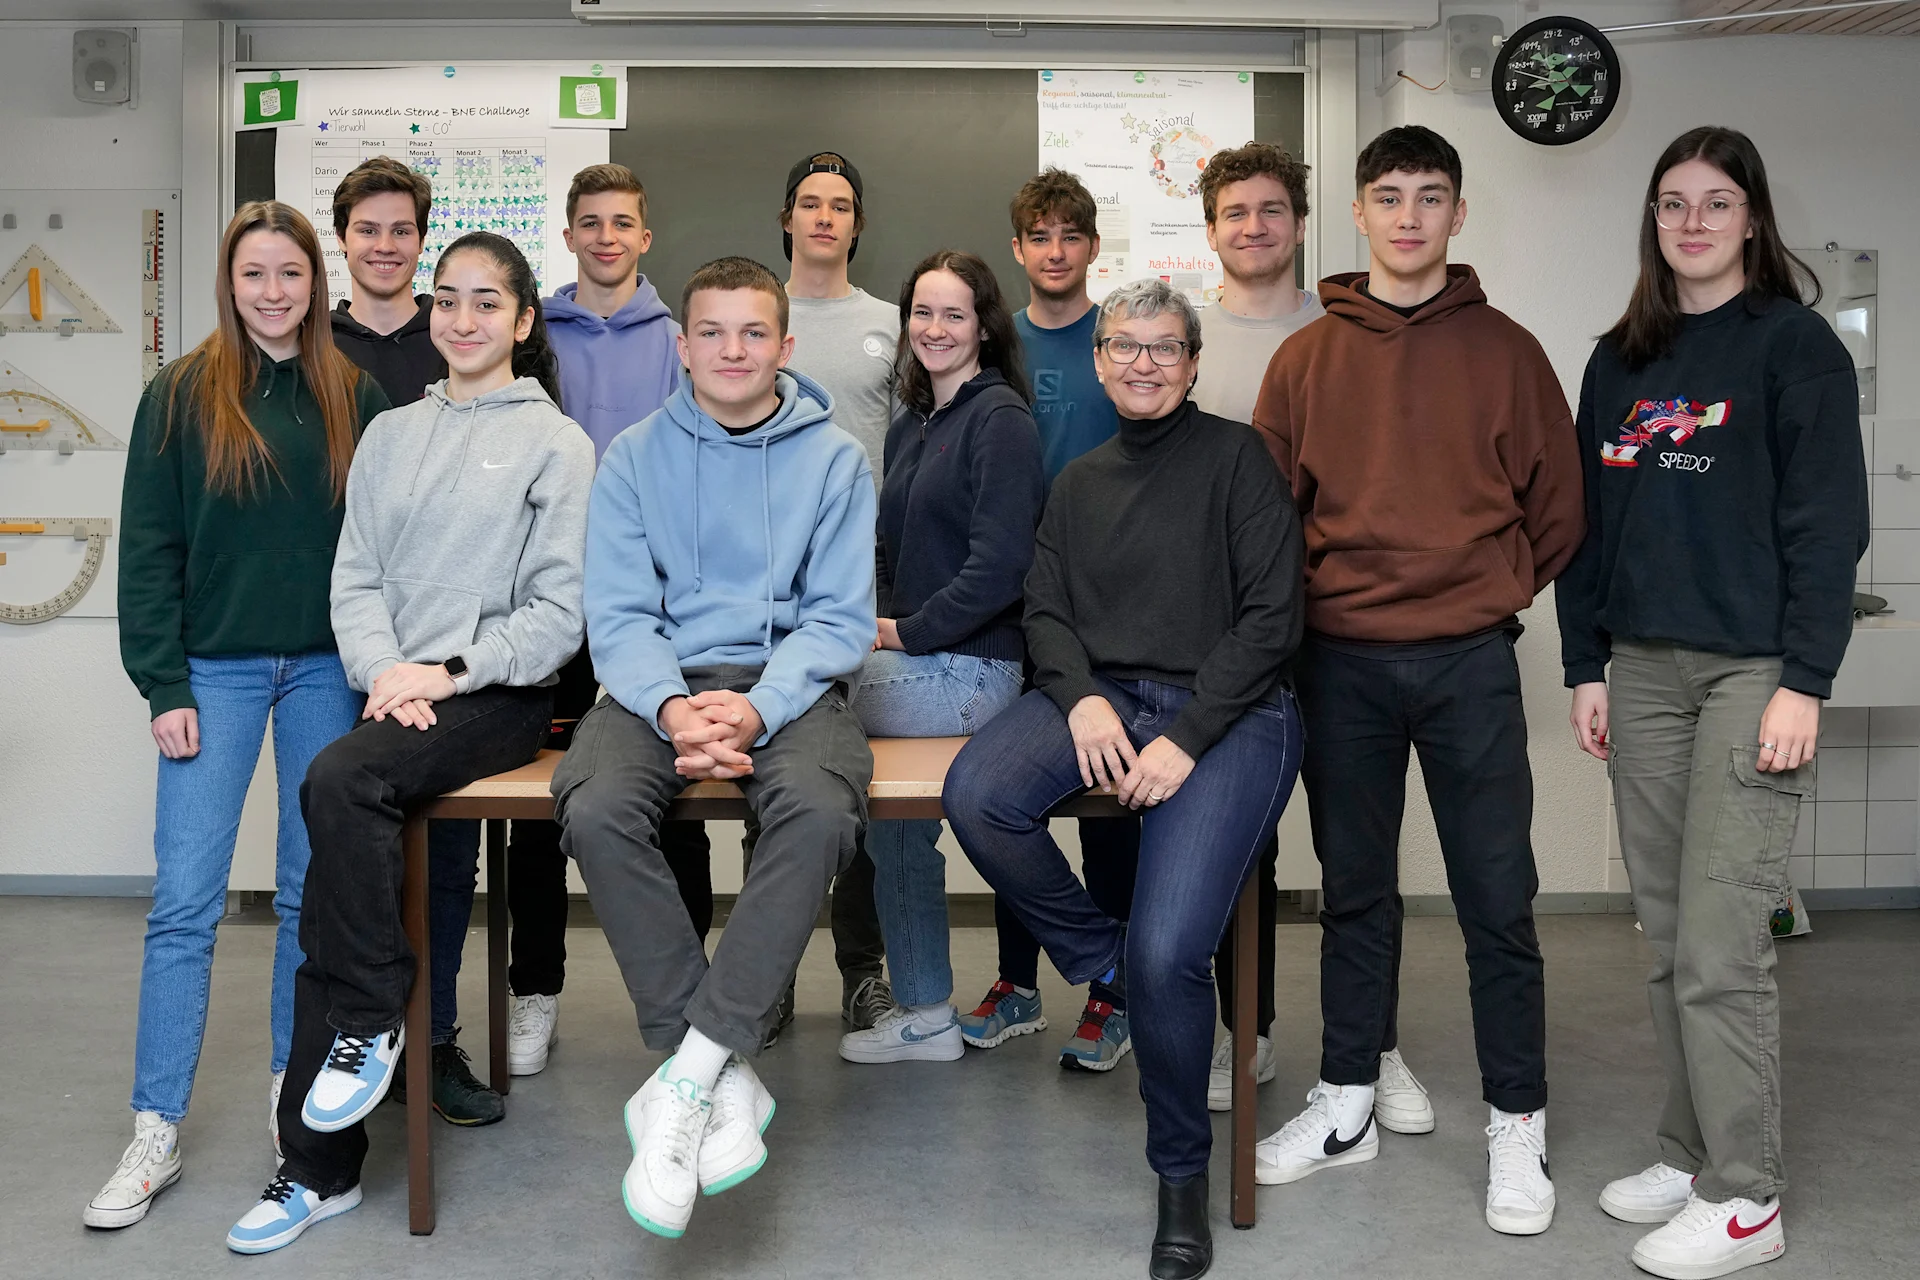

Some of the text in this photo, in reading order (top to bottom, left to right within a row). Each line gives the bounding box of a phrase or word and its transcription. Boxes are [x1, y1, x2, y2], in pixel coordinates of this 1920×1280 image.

[1080, 90, 1116, 99] saisonal,
[1116, 91, 1166, 99] klimaneutral
[329, 106, 350, 117] Wir
[351, 106, 401, 116] sammeln
[404, 107, 440, 117] Sterne
[451, 107, 476, 116] BNE
[479, 106, 530, 119] Challenge
[333, 119, 366, 133] Tierwohl
[1148, 111, 1195, 141] saisonal
[315, 167, 338, 175] Dario
[1093, 191, 1120, 205] ional
[315, 208, 334, 216] And
[315, 228, 337, 236] Flavi
[1148, 255, 1215, 271] nachhaltig
[325, 269, 340, 277] rah
[144, 344, 154, 352] 4
